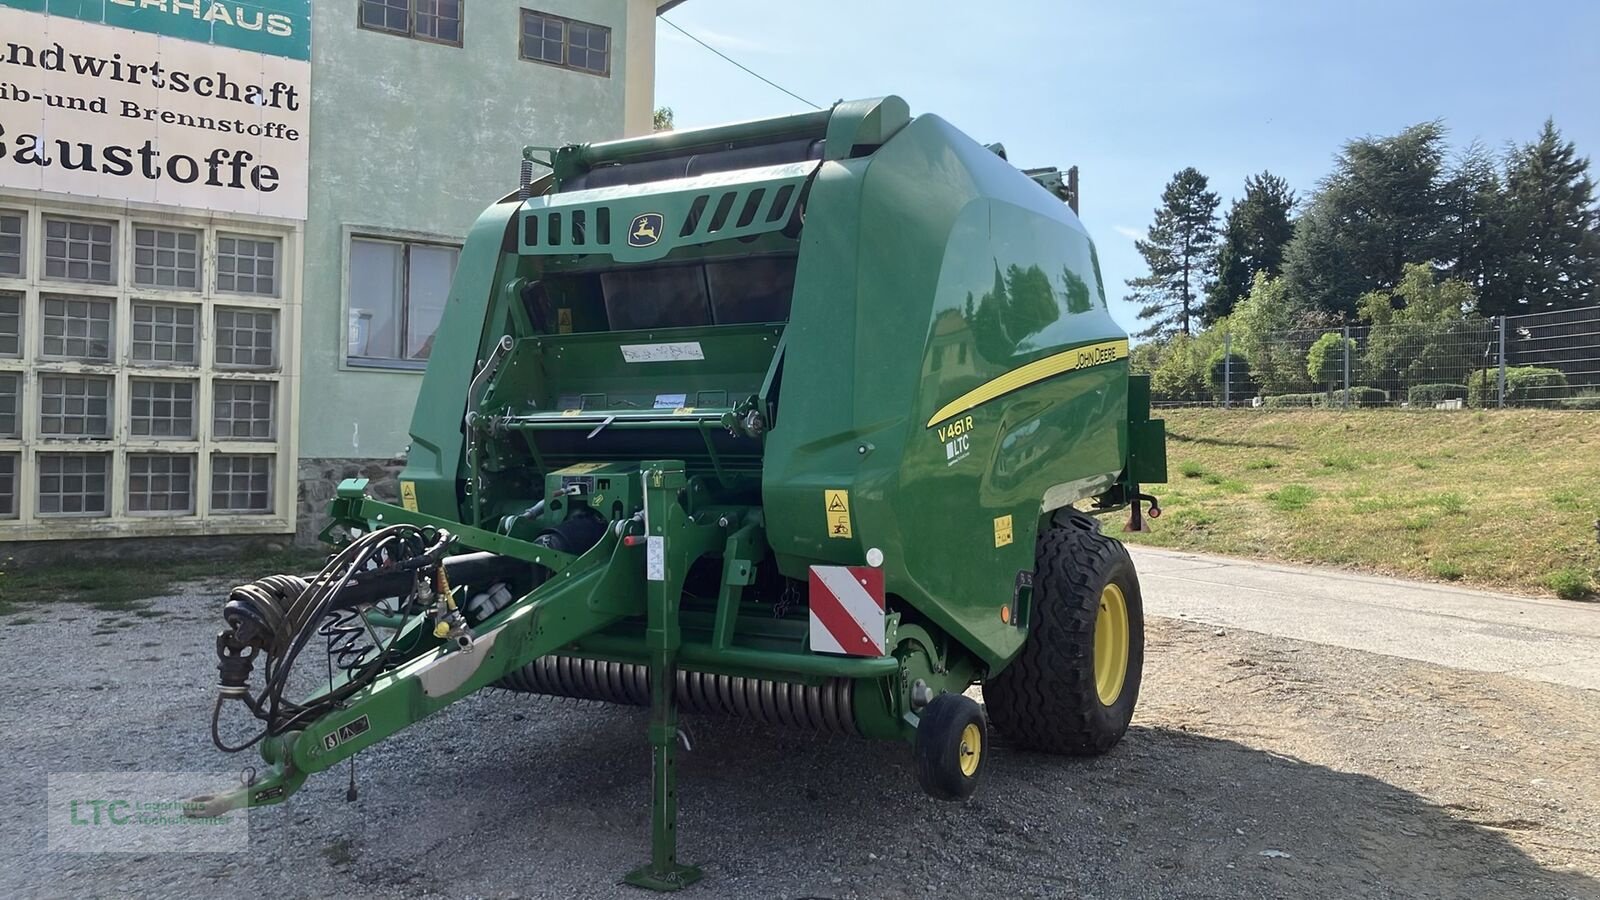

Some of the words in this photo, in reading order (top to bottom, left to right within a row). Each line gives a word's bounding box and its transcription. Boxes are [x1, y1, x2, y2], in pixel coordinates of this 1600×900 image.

[0, 43, 299, 111] ndwirtschaft
[120, 100, 299, 140] Brennstoffe
[0, 122, 279, 192] austoffe
[1075, 351, 1094, 369] JOHN
[1095, 347, 1117, 365] DEERE
[953, 434, 970, 455] LTC
